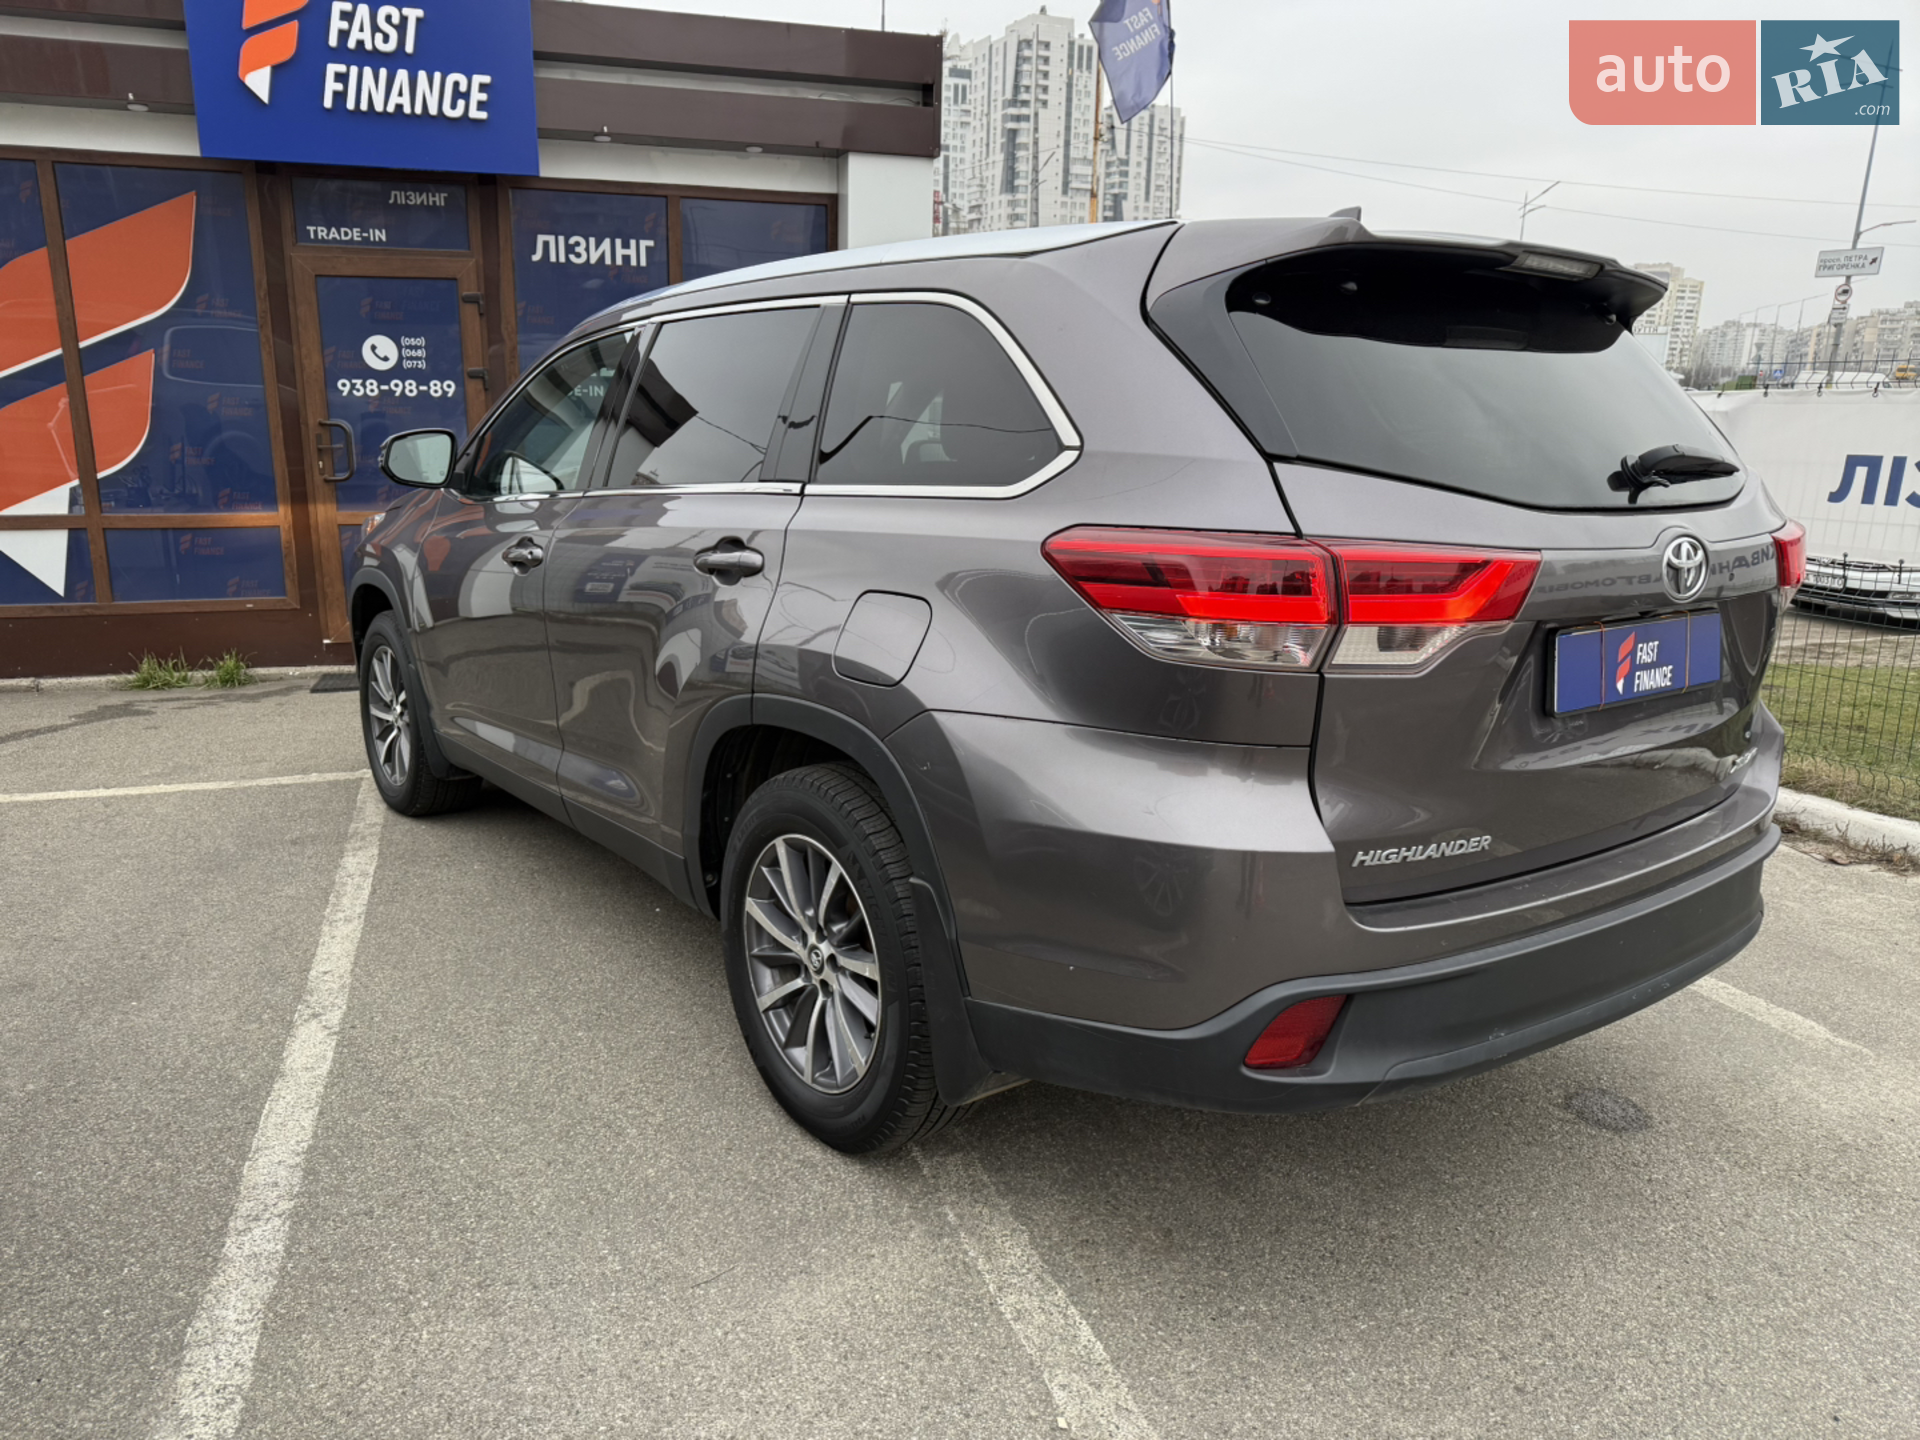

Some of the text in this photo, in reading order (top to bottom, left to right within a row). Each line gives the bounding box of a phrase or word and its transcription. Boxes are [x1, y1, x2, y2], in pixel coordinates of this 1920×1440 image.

[328, 1, 424, 54] FAST
[323, 62, 492, 120] FINANCE
[388, 190, 449, 207] ЛІЗИНГ
[306, 226, 388, 242] TRADE-IN
[531, 234, 655, 268] ЛІЗИНГ
[1843, 253, 1868, 263] ПЕТРА
[400, 336, 426, 347] (050)
[401, 347, 426, 358] (068)
[403, 358, 427, 370] (073)
[337, 378, 457, 398] 938-98-89
[567, 385, 604, 397] E-IN
[1636, 640, 1659, 665] FAST
[1633, 665, 1673, 693] FINANCE
[1351, 835, 1492, 868] HIGHLANDER
